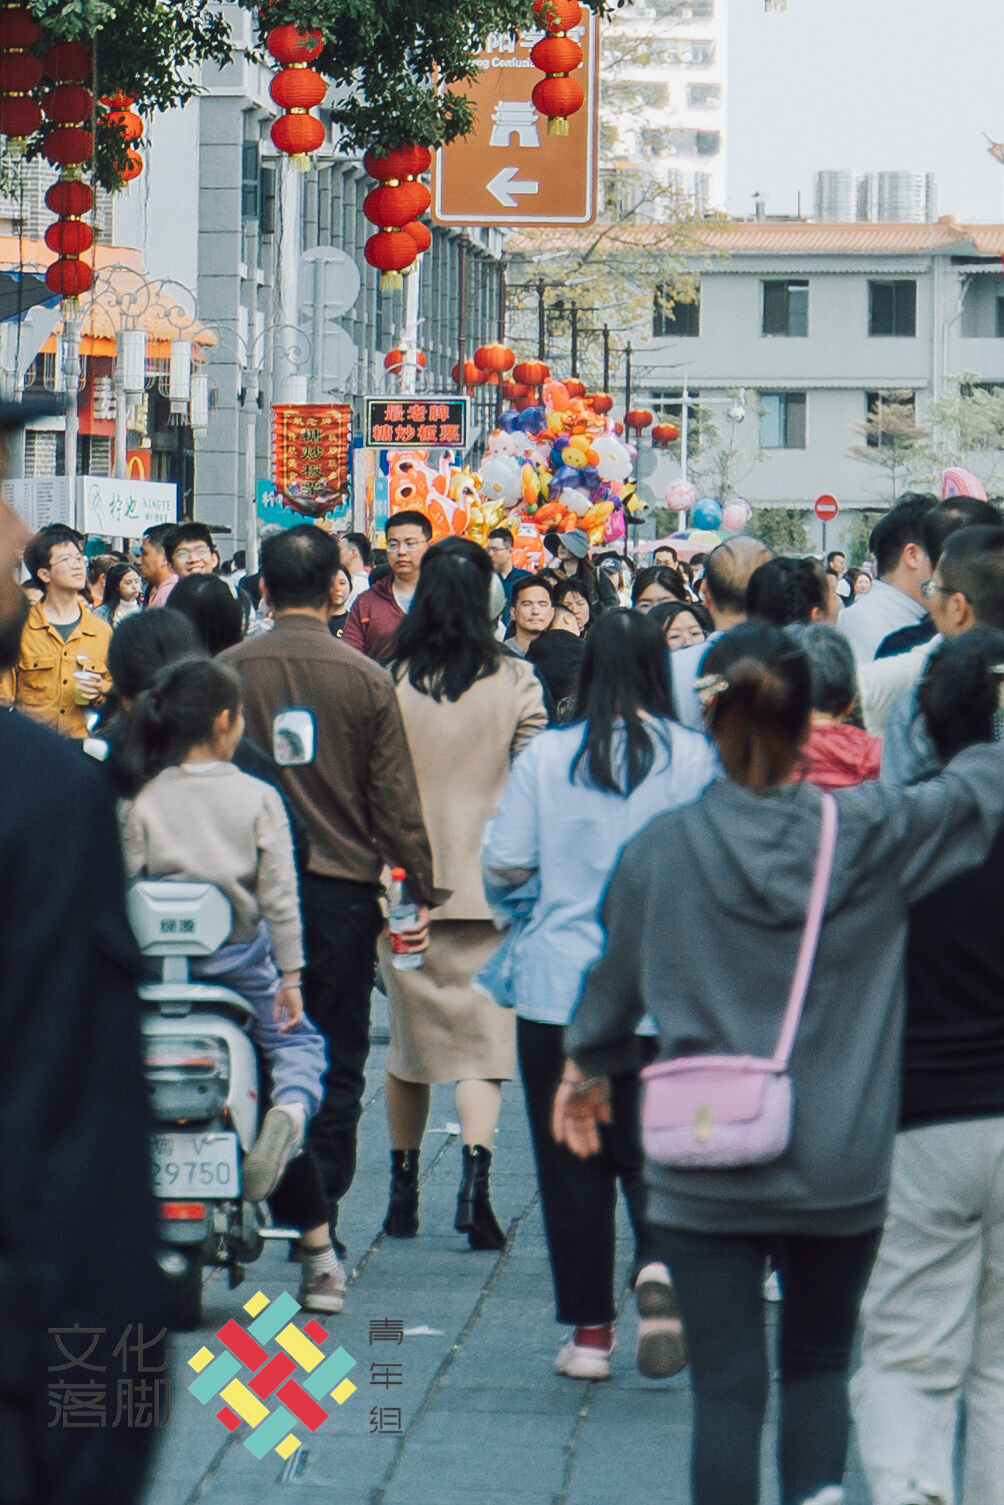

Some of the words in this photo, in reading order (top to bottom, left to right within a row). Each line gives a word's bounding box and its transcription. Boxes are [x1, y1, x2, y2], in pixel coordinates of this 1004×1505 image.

[384, 404, 450, 422] 最老牌
[372, 424, 461, 442] 糖炒板栗
